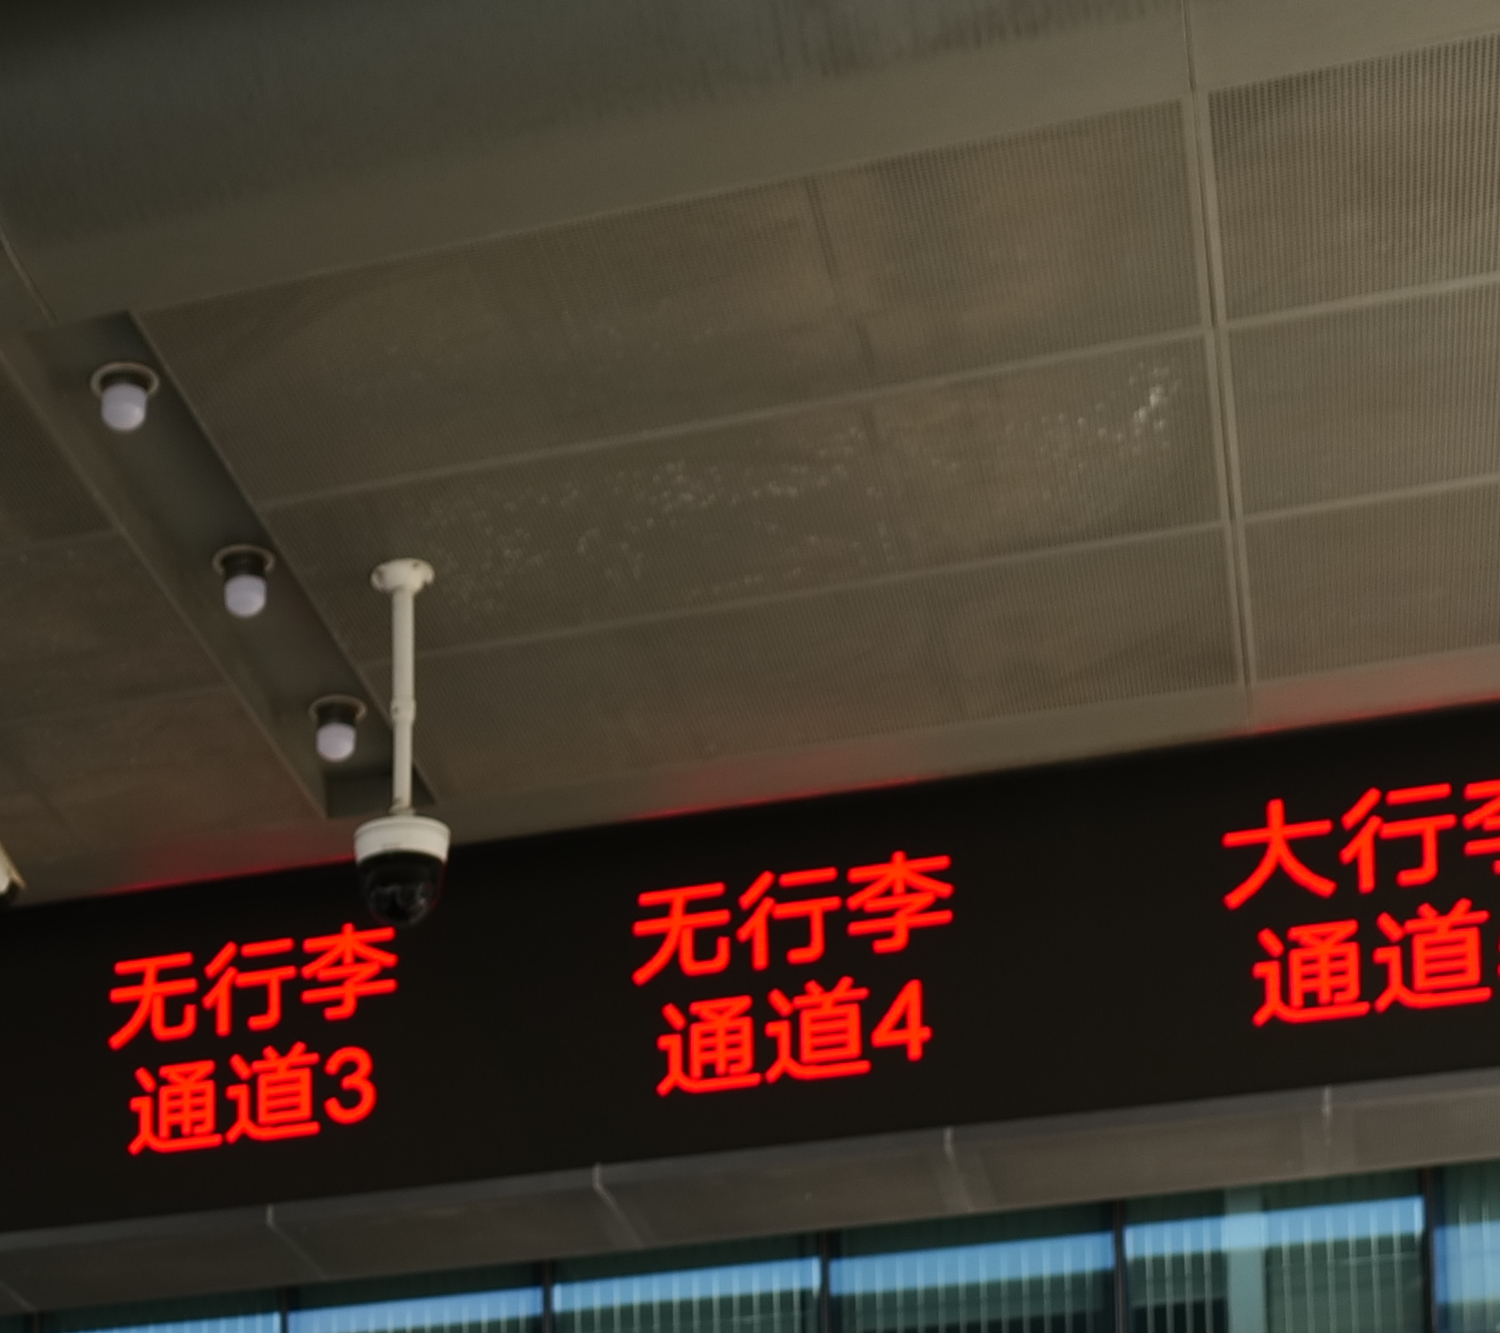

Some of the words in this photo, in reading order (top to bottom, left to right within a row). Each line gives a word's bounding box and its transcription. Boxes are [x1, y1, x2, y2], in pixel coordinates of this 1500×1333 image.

[631, 849, 954, 986] 无行李
[107, 921, 398, 1050] 无行李
[655, 974, 932, 1096] 通道4
[126, 1040, 377, 1155] 通道3
